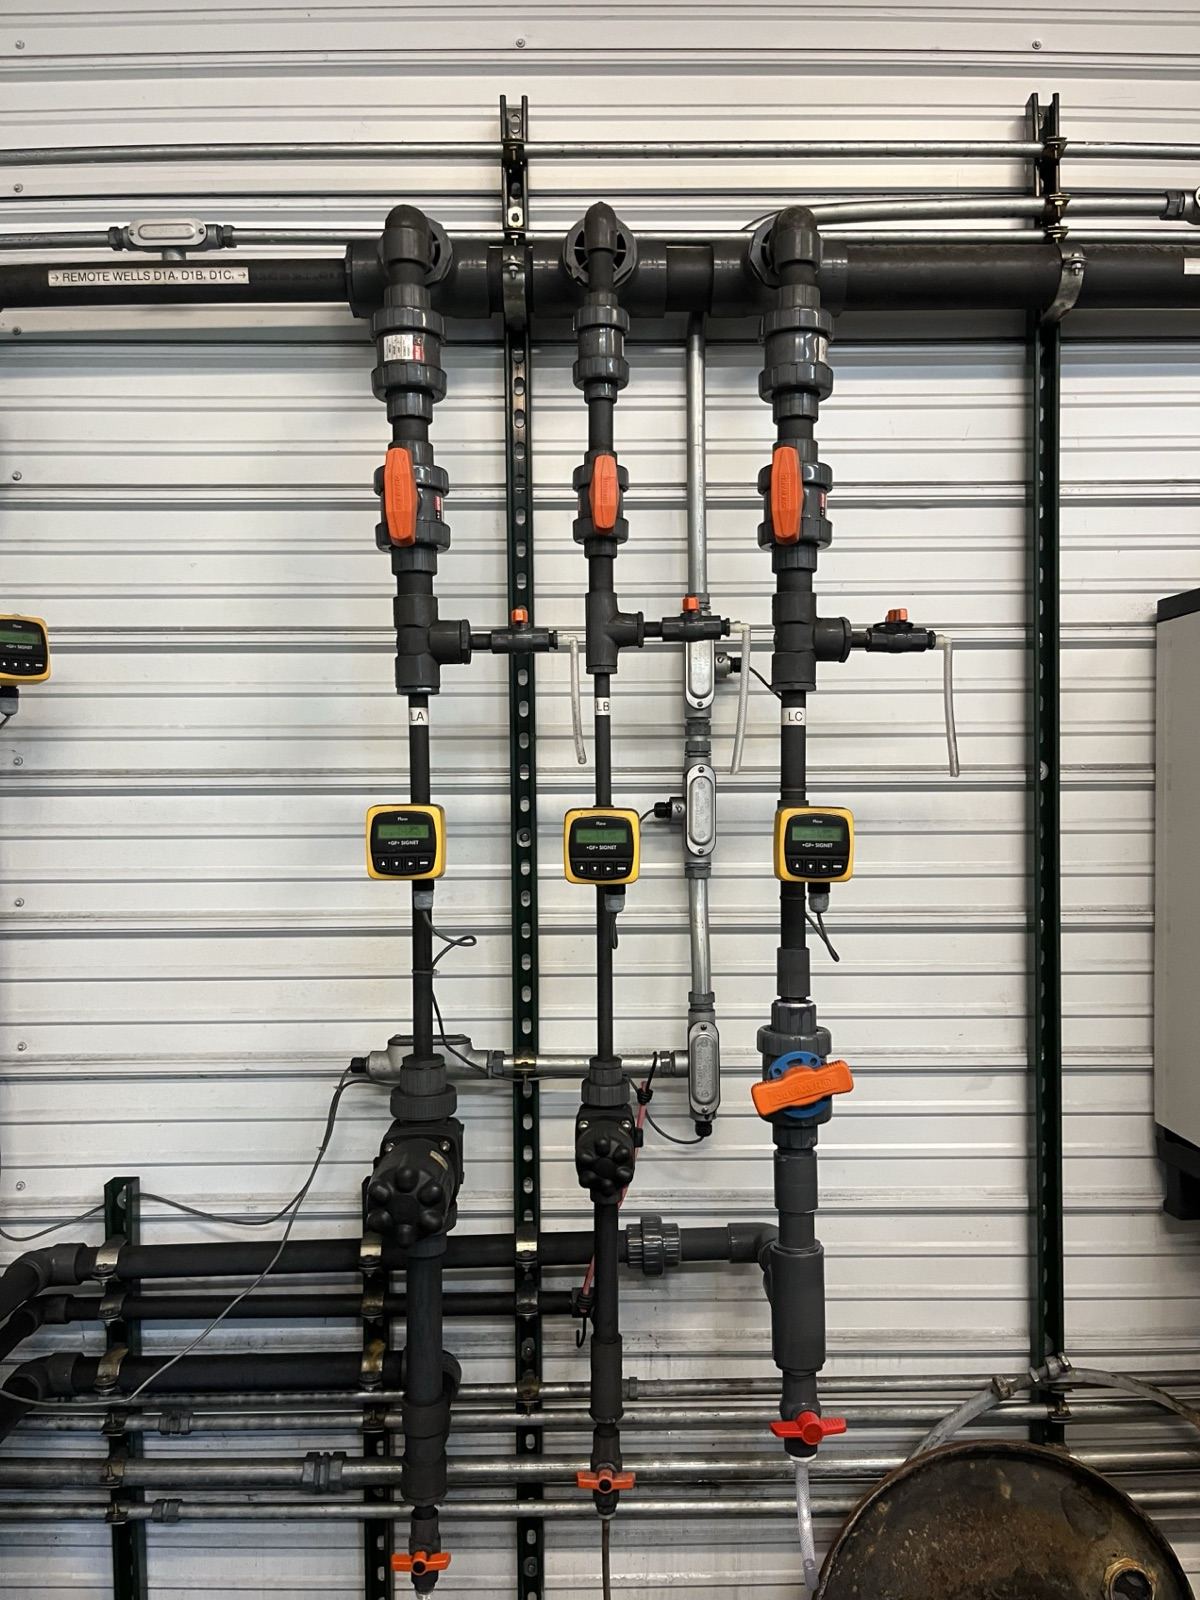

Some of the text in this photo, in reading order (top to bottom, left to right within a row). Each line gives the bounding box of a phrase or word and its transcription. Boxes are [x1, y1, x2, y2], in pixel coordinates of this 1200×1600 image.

[62, 272, 110, 282] REMOTE
[113, 271, 151, 281] WELLS
[596, 701, 609, 711] LB
[410, 711, 424, 721] LA
[788, 711, 802, 721] LC
